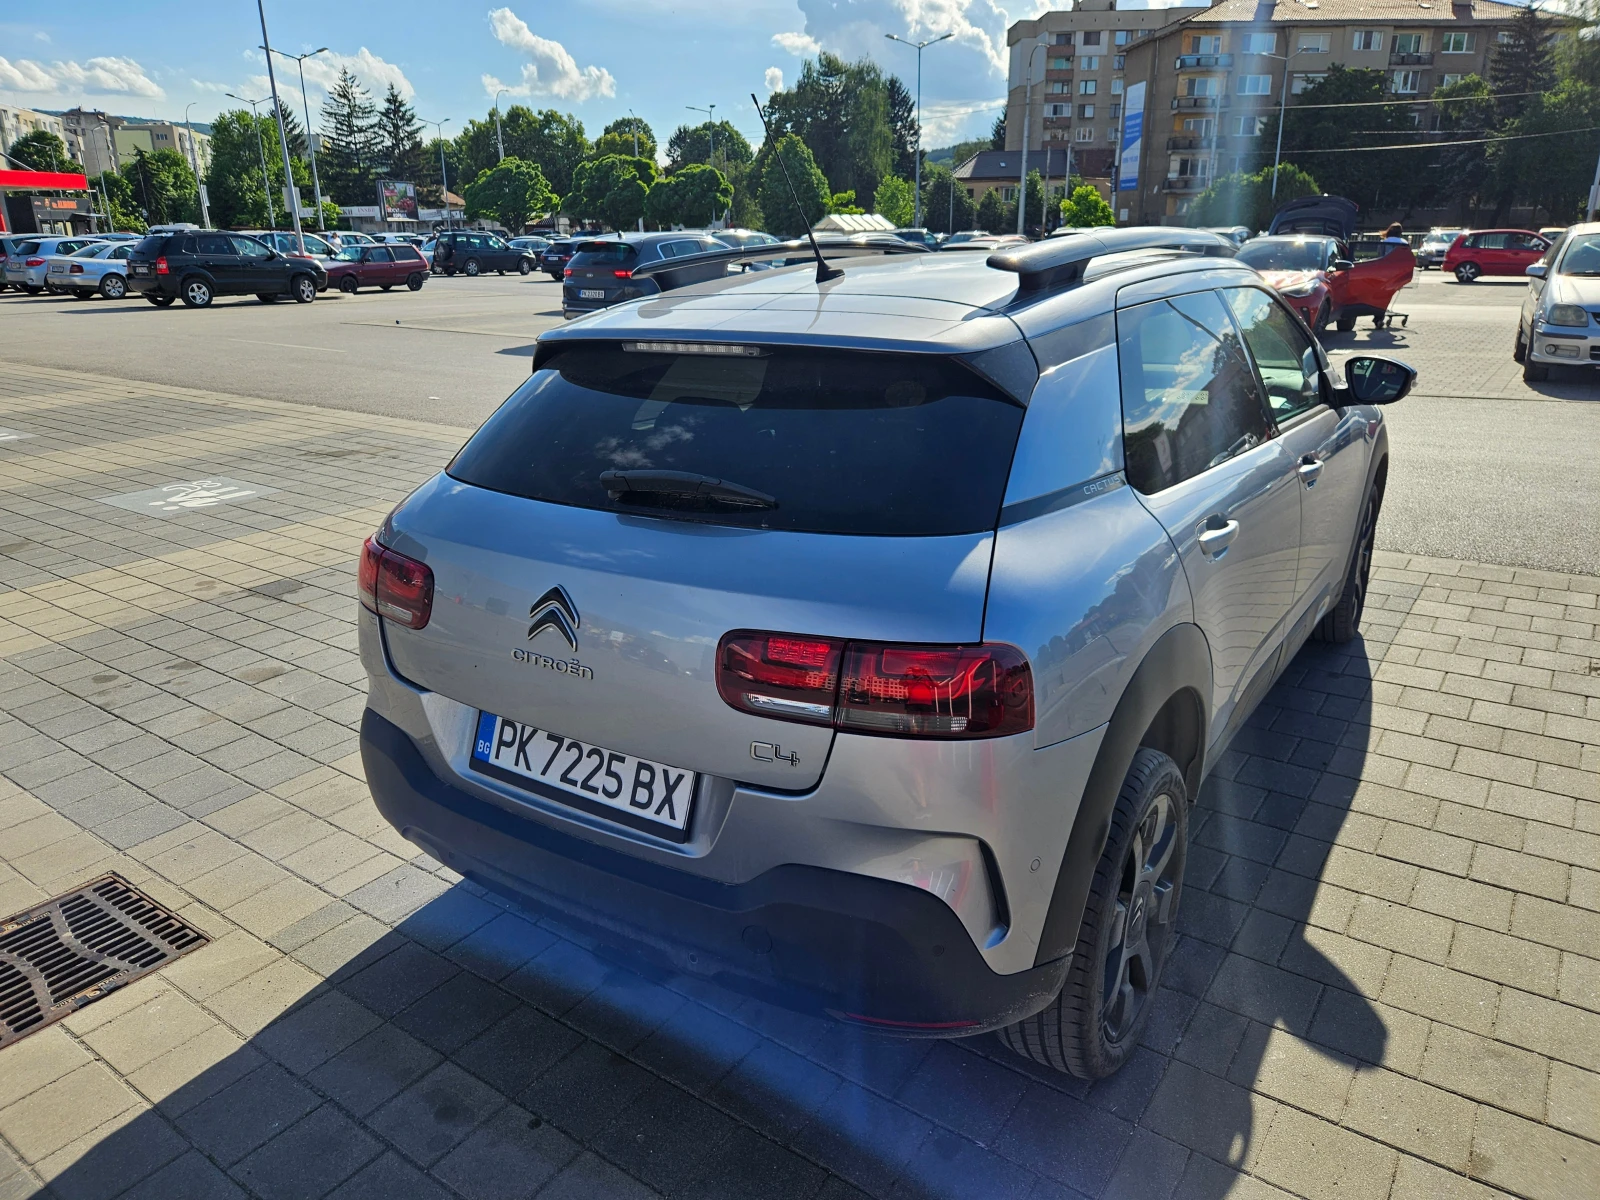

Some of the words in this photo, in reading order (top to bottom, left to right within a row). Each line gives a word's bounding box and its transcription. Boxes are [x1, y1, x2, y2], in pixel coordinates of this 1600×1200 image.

[1083, 474, 1121, 495] CACTUS
[510, 647, 594, 681] CITROËN
[477, 739, 491, 755] BG
[750, 740, 801, 767] C4
[494, 718, 539, 772] PK
[540, 732, 626, 800] 7225
[629, 761, 685, 821] BX
